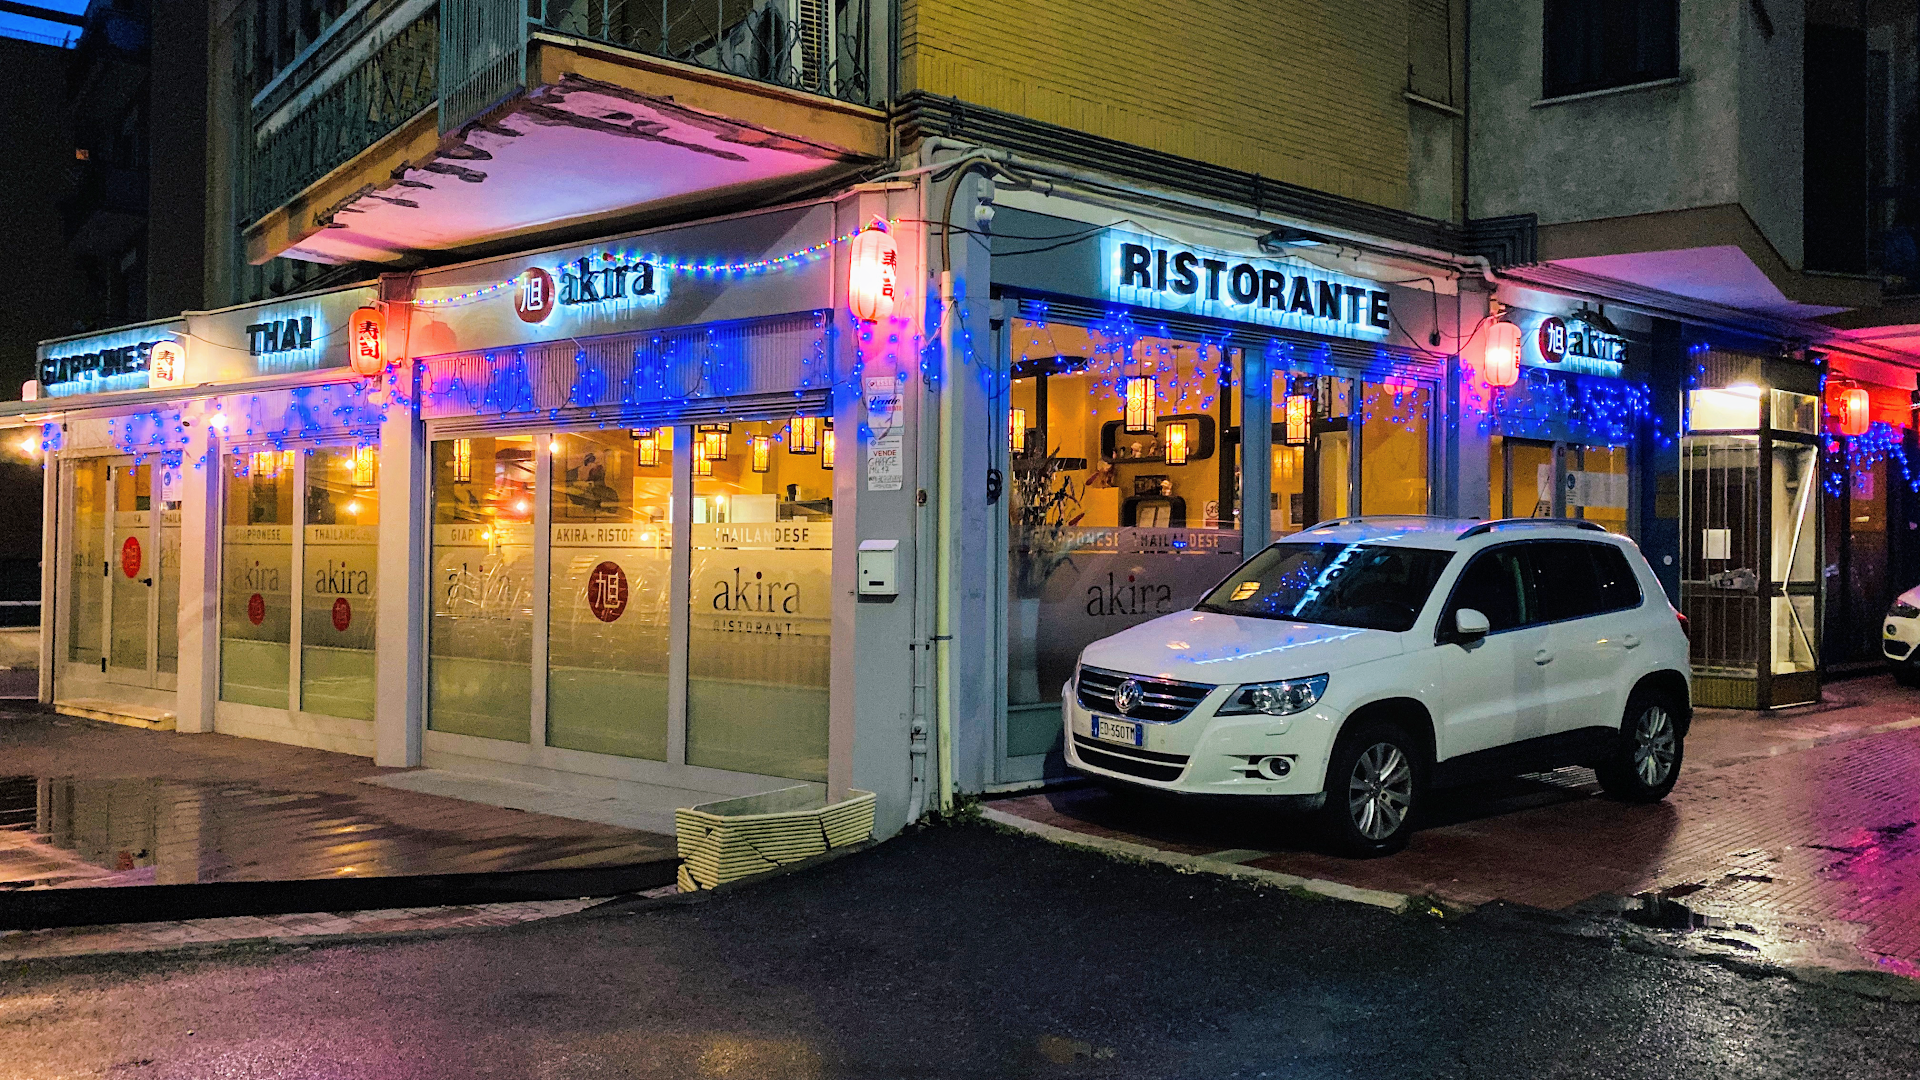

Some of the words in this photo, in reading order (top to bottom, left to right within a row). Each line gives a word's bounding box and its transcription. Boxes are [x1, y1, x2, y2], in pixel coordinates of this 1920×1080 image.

[558, 253, 656, 305] akira
[1120, 242, 1390, 329] RISTORANTE
[246, 316, 312, 356] THAI
[40, 339, 165, 386] GIAPPONES
[556, 528, 589, 542] AKIRA
[714, 527, 810, 543] THAILANDESE
[315, 559, 368, 594] akira
[713, 566, 802, 614] akira
[1086, 571, 1173, 616] akira
